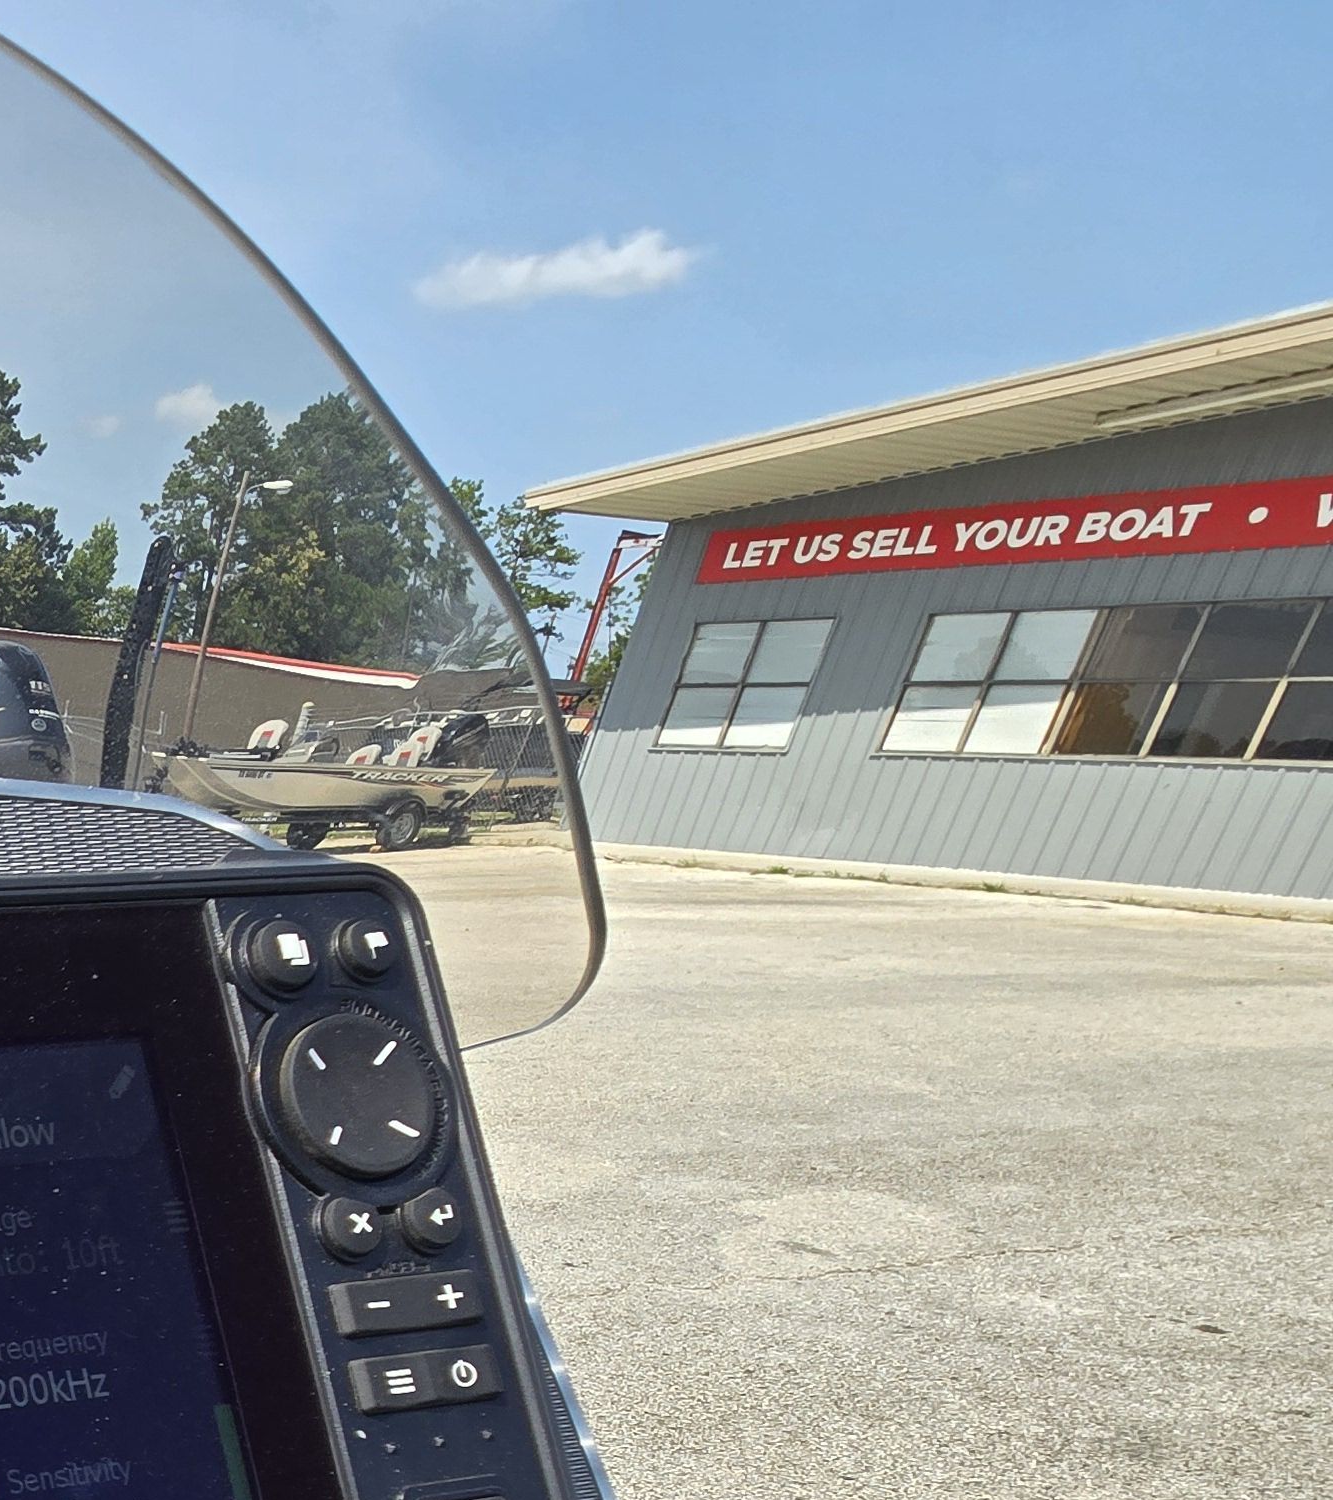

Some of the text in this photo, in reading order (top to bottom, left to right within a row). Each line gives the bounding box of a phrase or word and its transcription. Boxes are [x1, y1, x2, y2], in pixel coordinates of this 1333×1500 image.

[723, 503, 1212, 569] LET US SELL YOUR BOAT
[351, 770, 449, 782] TRACKER
[7, 1457, 132, 1494] Sensitivity
